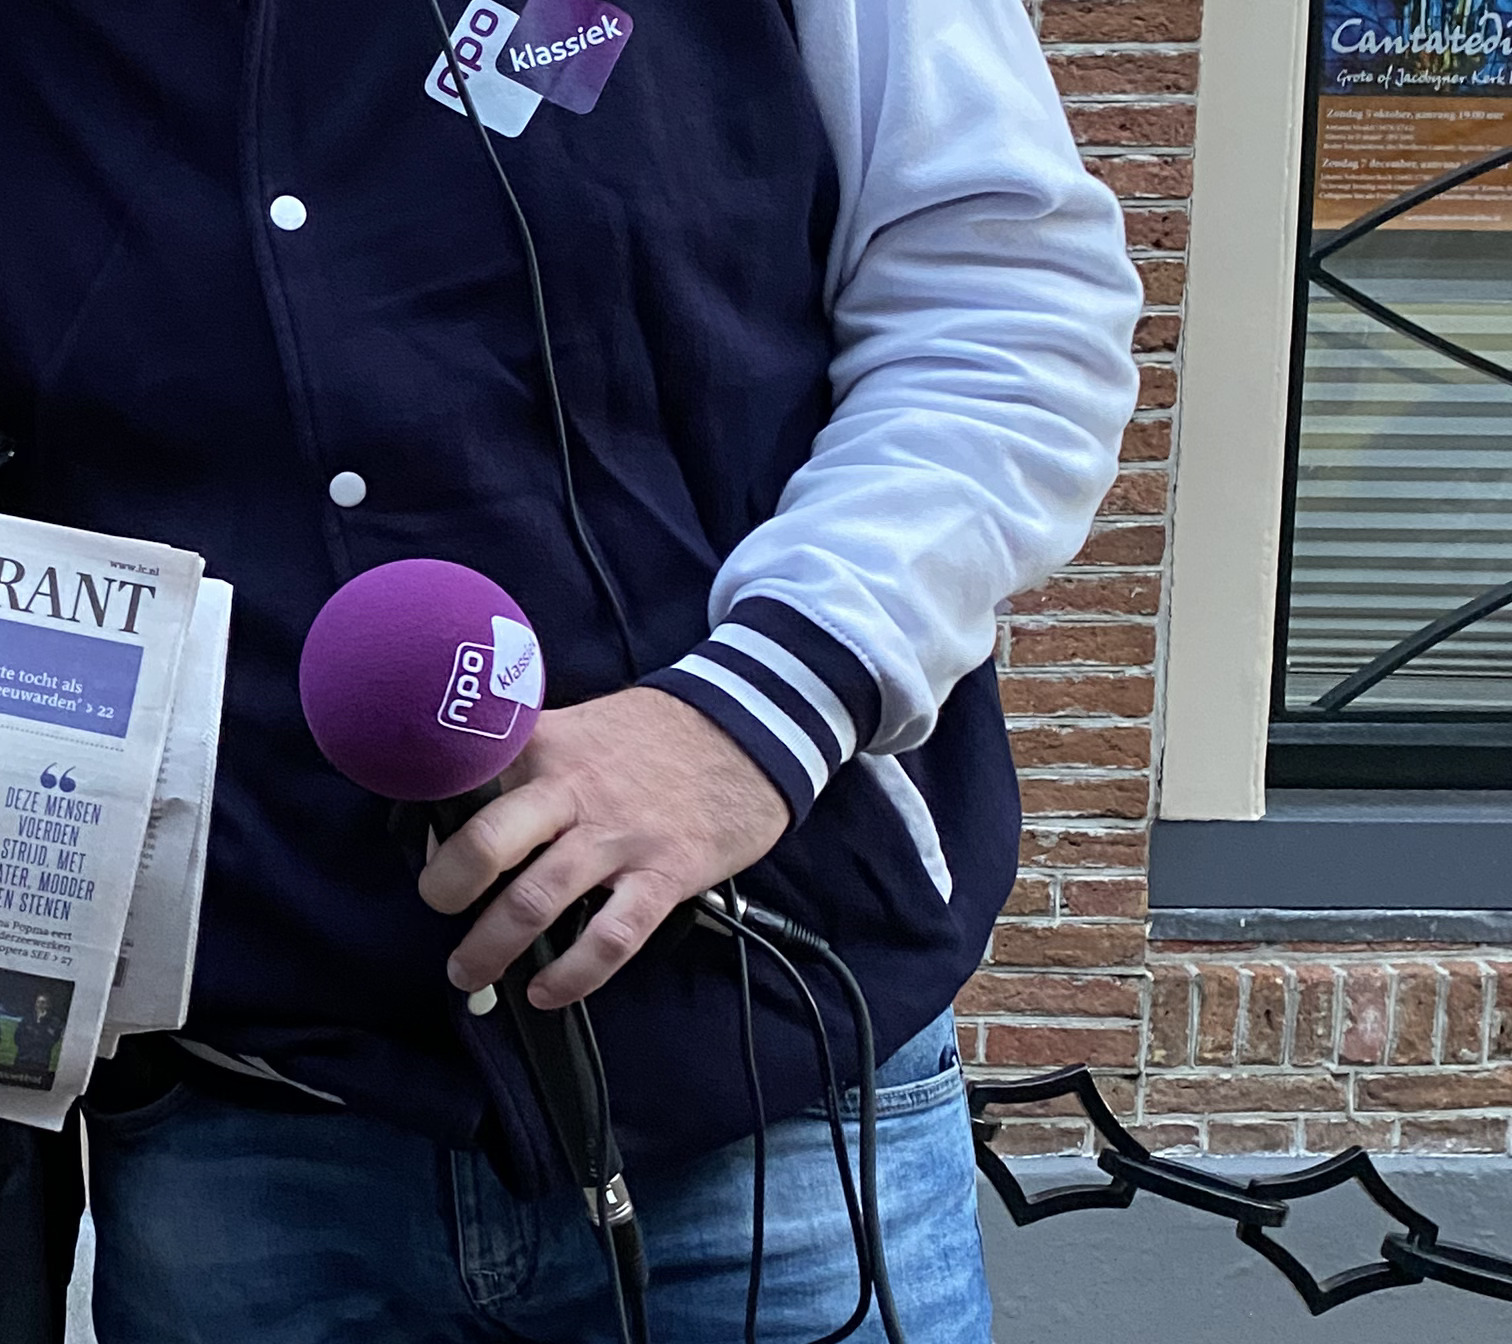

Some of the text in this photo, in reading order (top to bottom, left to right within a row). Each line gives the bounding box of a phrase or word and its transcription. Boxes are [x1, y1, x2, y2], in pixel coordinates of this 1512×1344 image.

[436, 8, 499, 99] npo
[508, 14, 624, 73] klassiek
[1337, 69, 1373, 87] Grote
[1377, 64, 1393, 90] of
[1472, 66, 1505, 85] Kerk
[1326, 108, 1364, 121] Zondag
[109, 559, 159, 576] www.lc.nl
[18, 668, 58, 692] tocht
[61, 677, 83, 694] als
[447, 650, 484, 723] npo
[97, 705, 114, 719] 22
[5, 786, 102, 825] DEZE MENSEN
[18, 814, 79, 847] VOERDEN
[57, 852, 85, 874] MET
[38, 871, 95, 901] MODDER
[19, 892, 71, 921] STENEN
[30, 949, 51, 961] SEE
